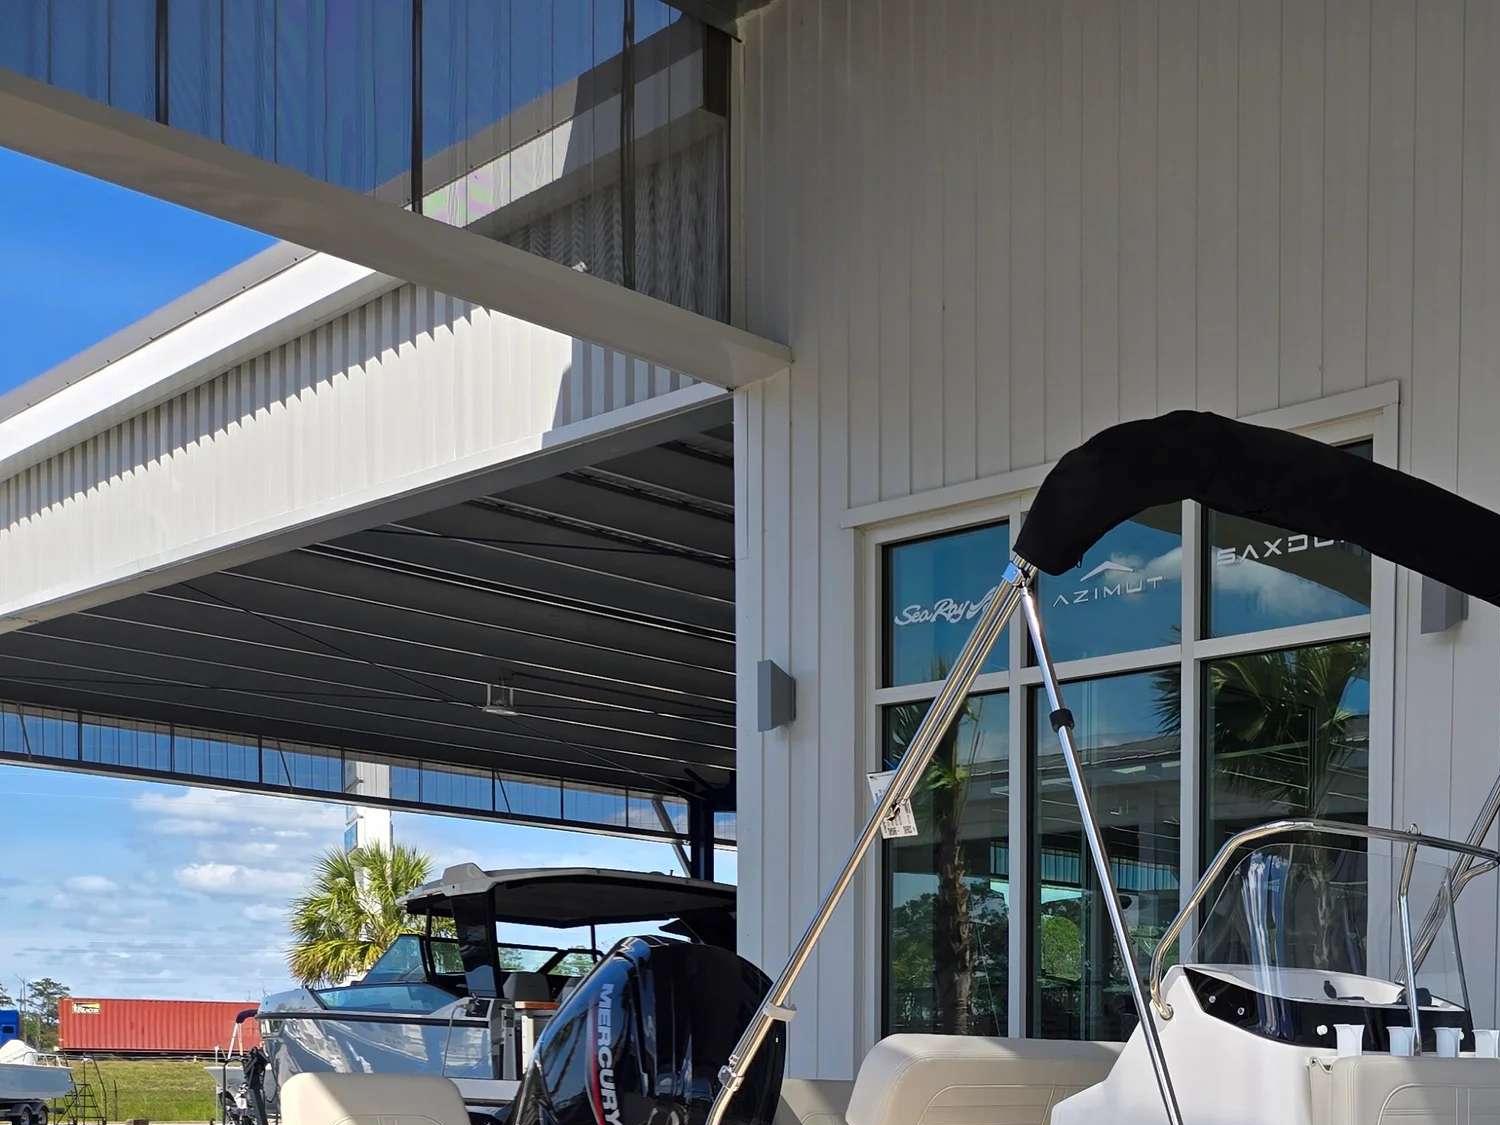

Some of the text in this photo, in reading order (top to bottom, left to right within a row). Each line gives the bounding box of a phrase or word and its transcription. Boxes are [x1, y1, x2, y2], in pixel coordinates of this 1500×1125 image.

[1216, 534, 1346, 567] SAXD
[1052, 575, 1163, 608] AZIMUT
[893, 598, 971, 626] Sea Ray
